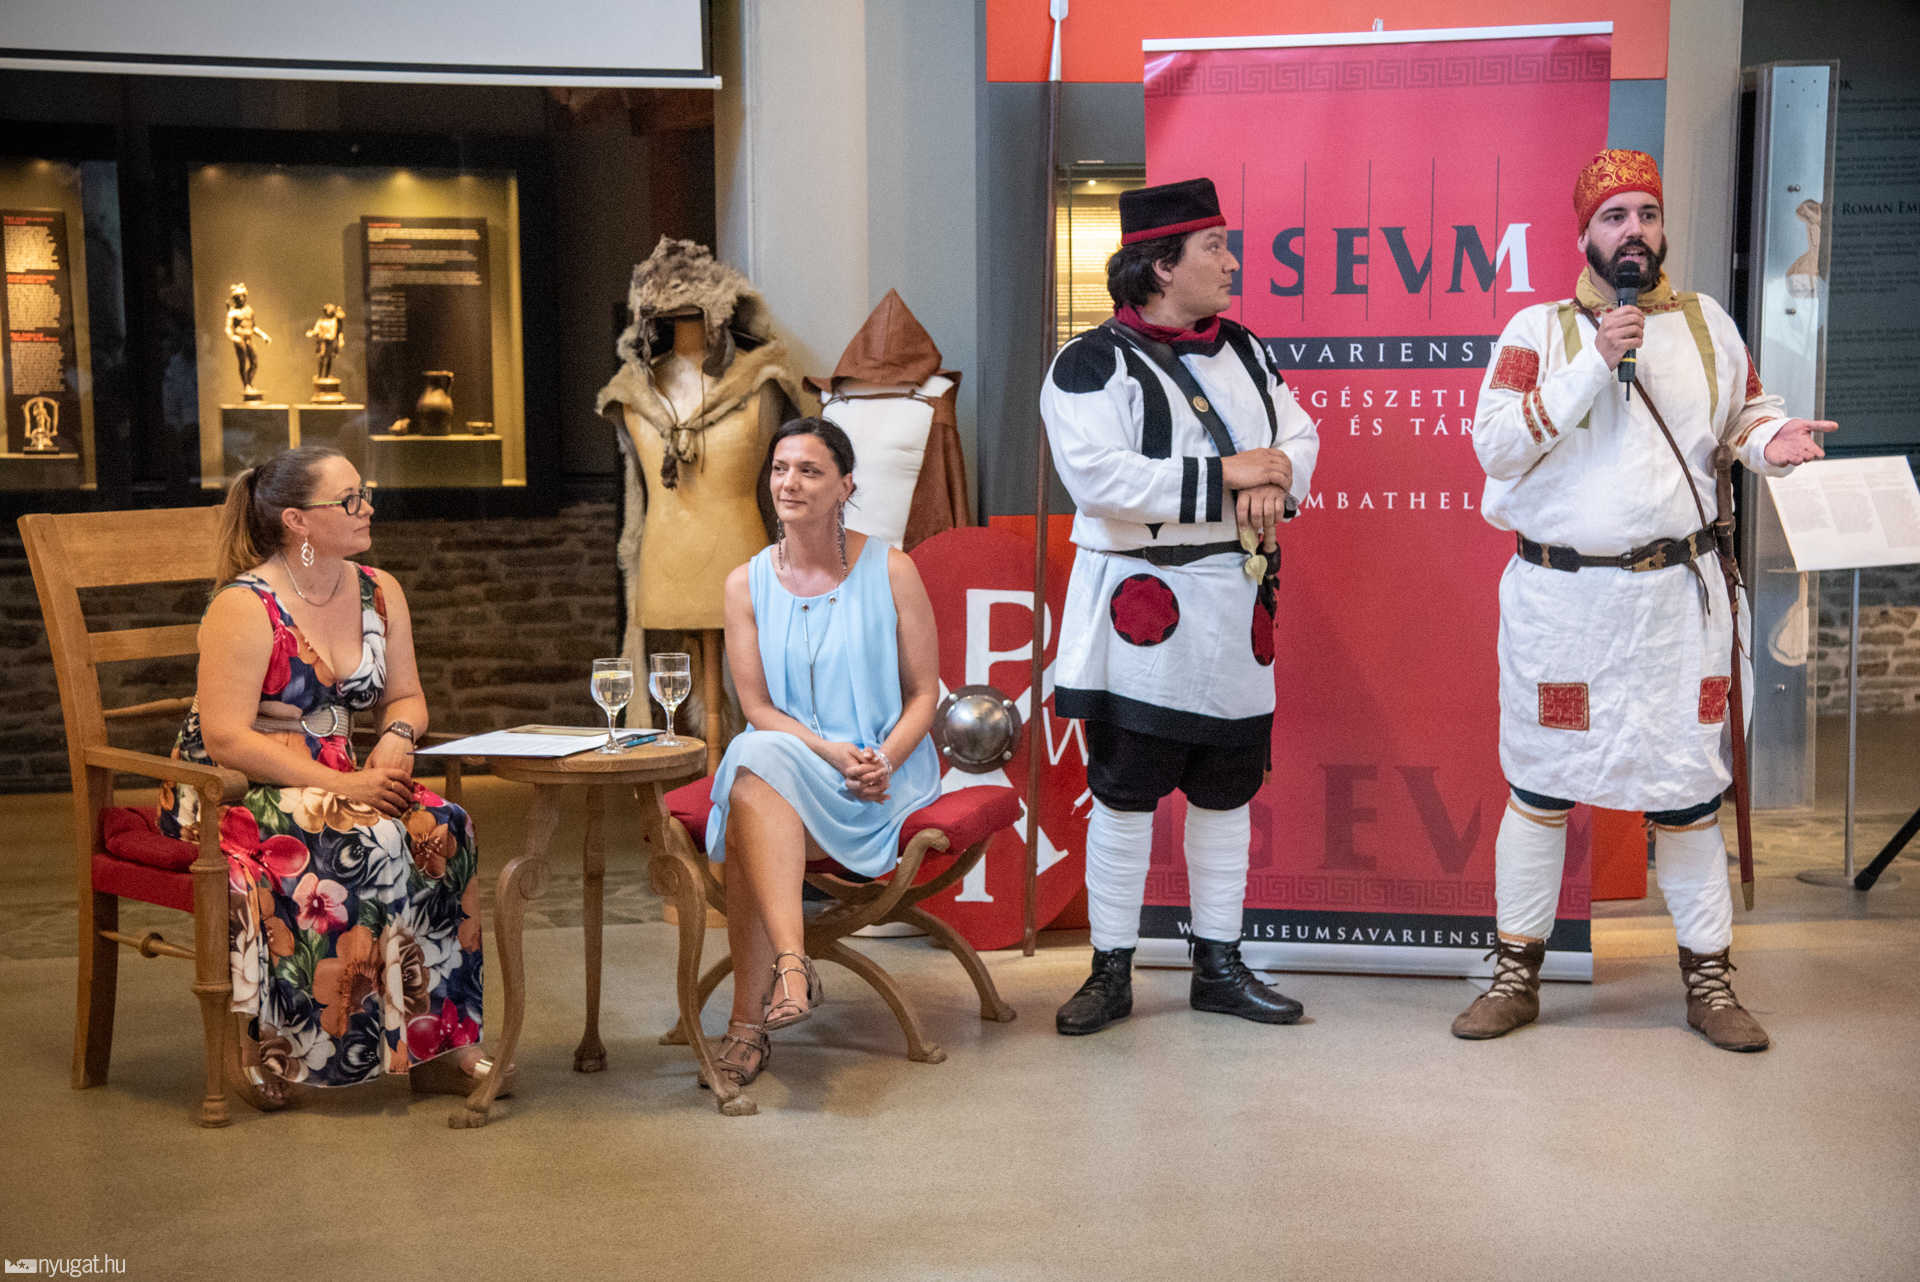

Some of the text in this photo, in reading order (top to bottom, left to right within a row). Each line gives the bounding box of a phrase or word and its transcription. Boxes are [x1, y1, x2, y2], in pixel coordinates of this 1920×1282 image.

[1842, 202, 1894, 215] ROMAN
[1350, 414, 1473, 436] ÉS TÁR
[1305, 491, 1474, 509] MBATHEL
[1177, 921, 1496, 945] W.ISEUMSAVARIENSE
